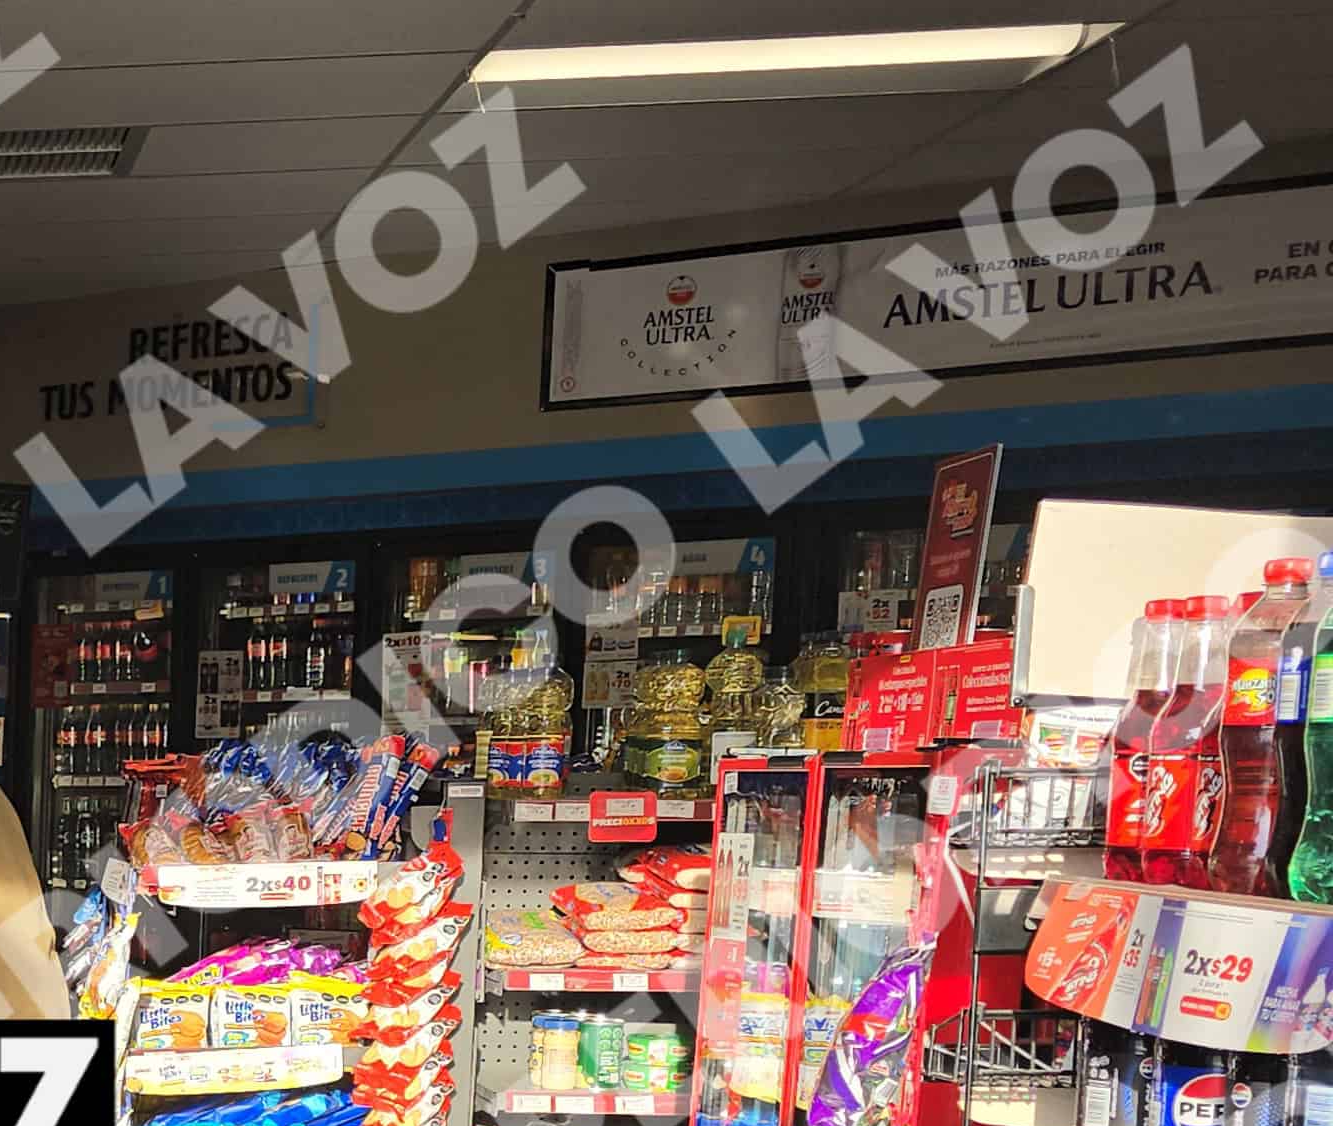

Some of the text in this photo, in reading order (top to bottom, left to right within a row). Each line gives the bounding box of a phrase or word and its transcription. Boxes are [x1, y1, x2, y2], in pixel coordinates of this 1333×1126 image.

[934, 240, 1166, 279] MÁS RAZONES PARA ELEGIR
[1288, 241, 1319, 258] EN
[1253, 264, 1311, 284] PARA
[883, 261, 1214, 329] AMSTEL ULTRA
[644, 305, 714, 328] AMSTEL
[129, 311, 294, 363] REFRESCA
[39, 361, 294, 421] TUS MOMENTOS
[749, 545, 766, 566] 4
[533, 558, 547, 577] 3
[156, 575, 168, 593] 1
[335, 568, 349, 588] 2
[246, 875, 311, 893] 2x$40
[1184, 949, 1254, 983] 2x$29
[140, 1005, 171, 1024] Little
[224, 1001, 253, 1017] Little
[234, 1008, 267, 1024] Bites
[299, 1001, 330, 1017] Little
[309, 1007, 341, 1025] Bites
[150, 1010, 183, 1030] Bites
